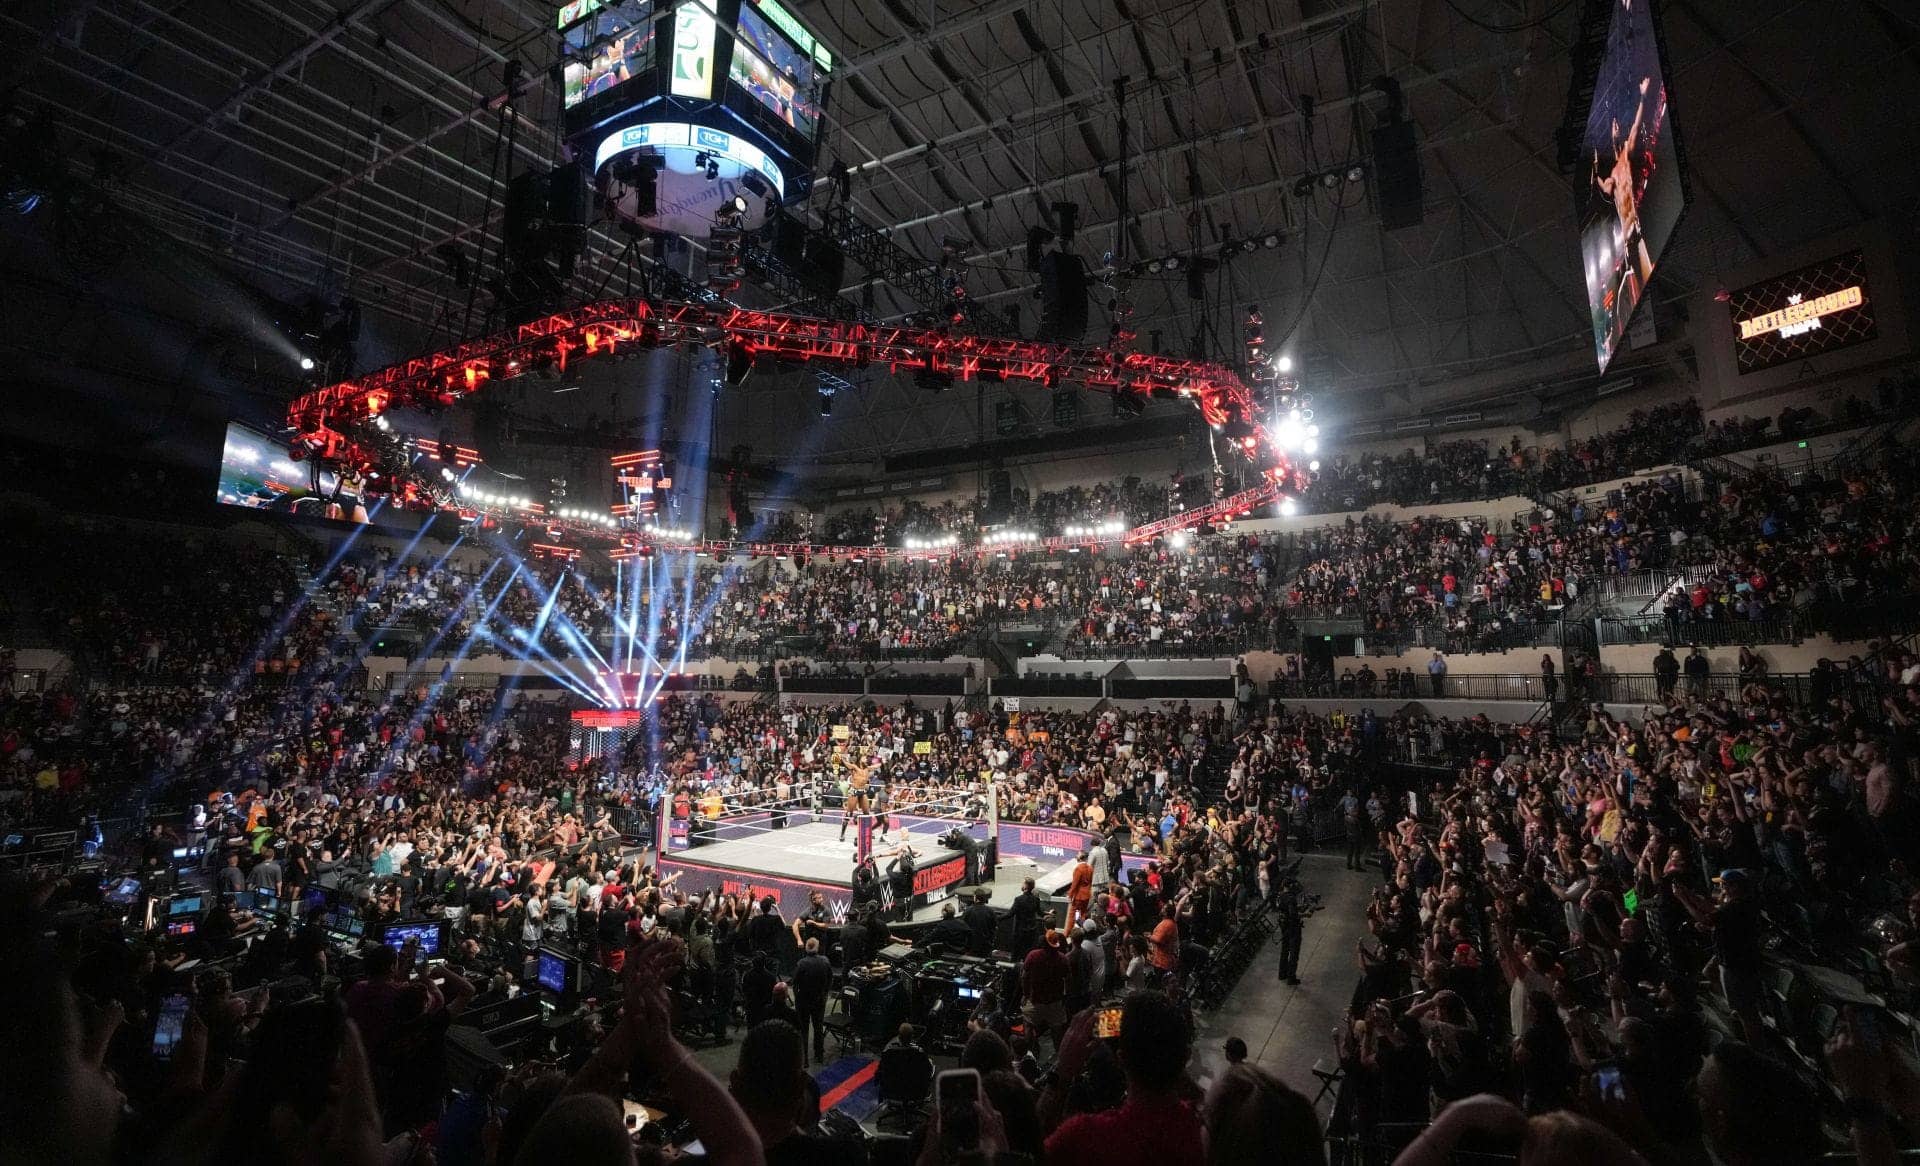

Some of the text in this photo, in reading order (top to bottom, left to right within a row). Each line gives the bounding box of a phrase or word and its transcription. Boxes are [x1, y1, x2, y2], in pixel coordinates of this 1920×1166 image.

[703, 131, 728, 147] TGH
[1020, 829, 1083, 851] BATTLEGROUND
[1042, 845, 1065, 857] TAMPA
